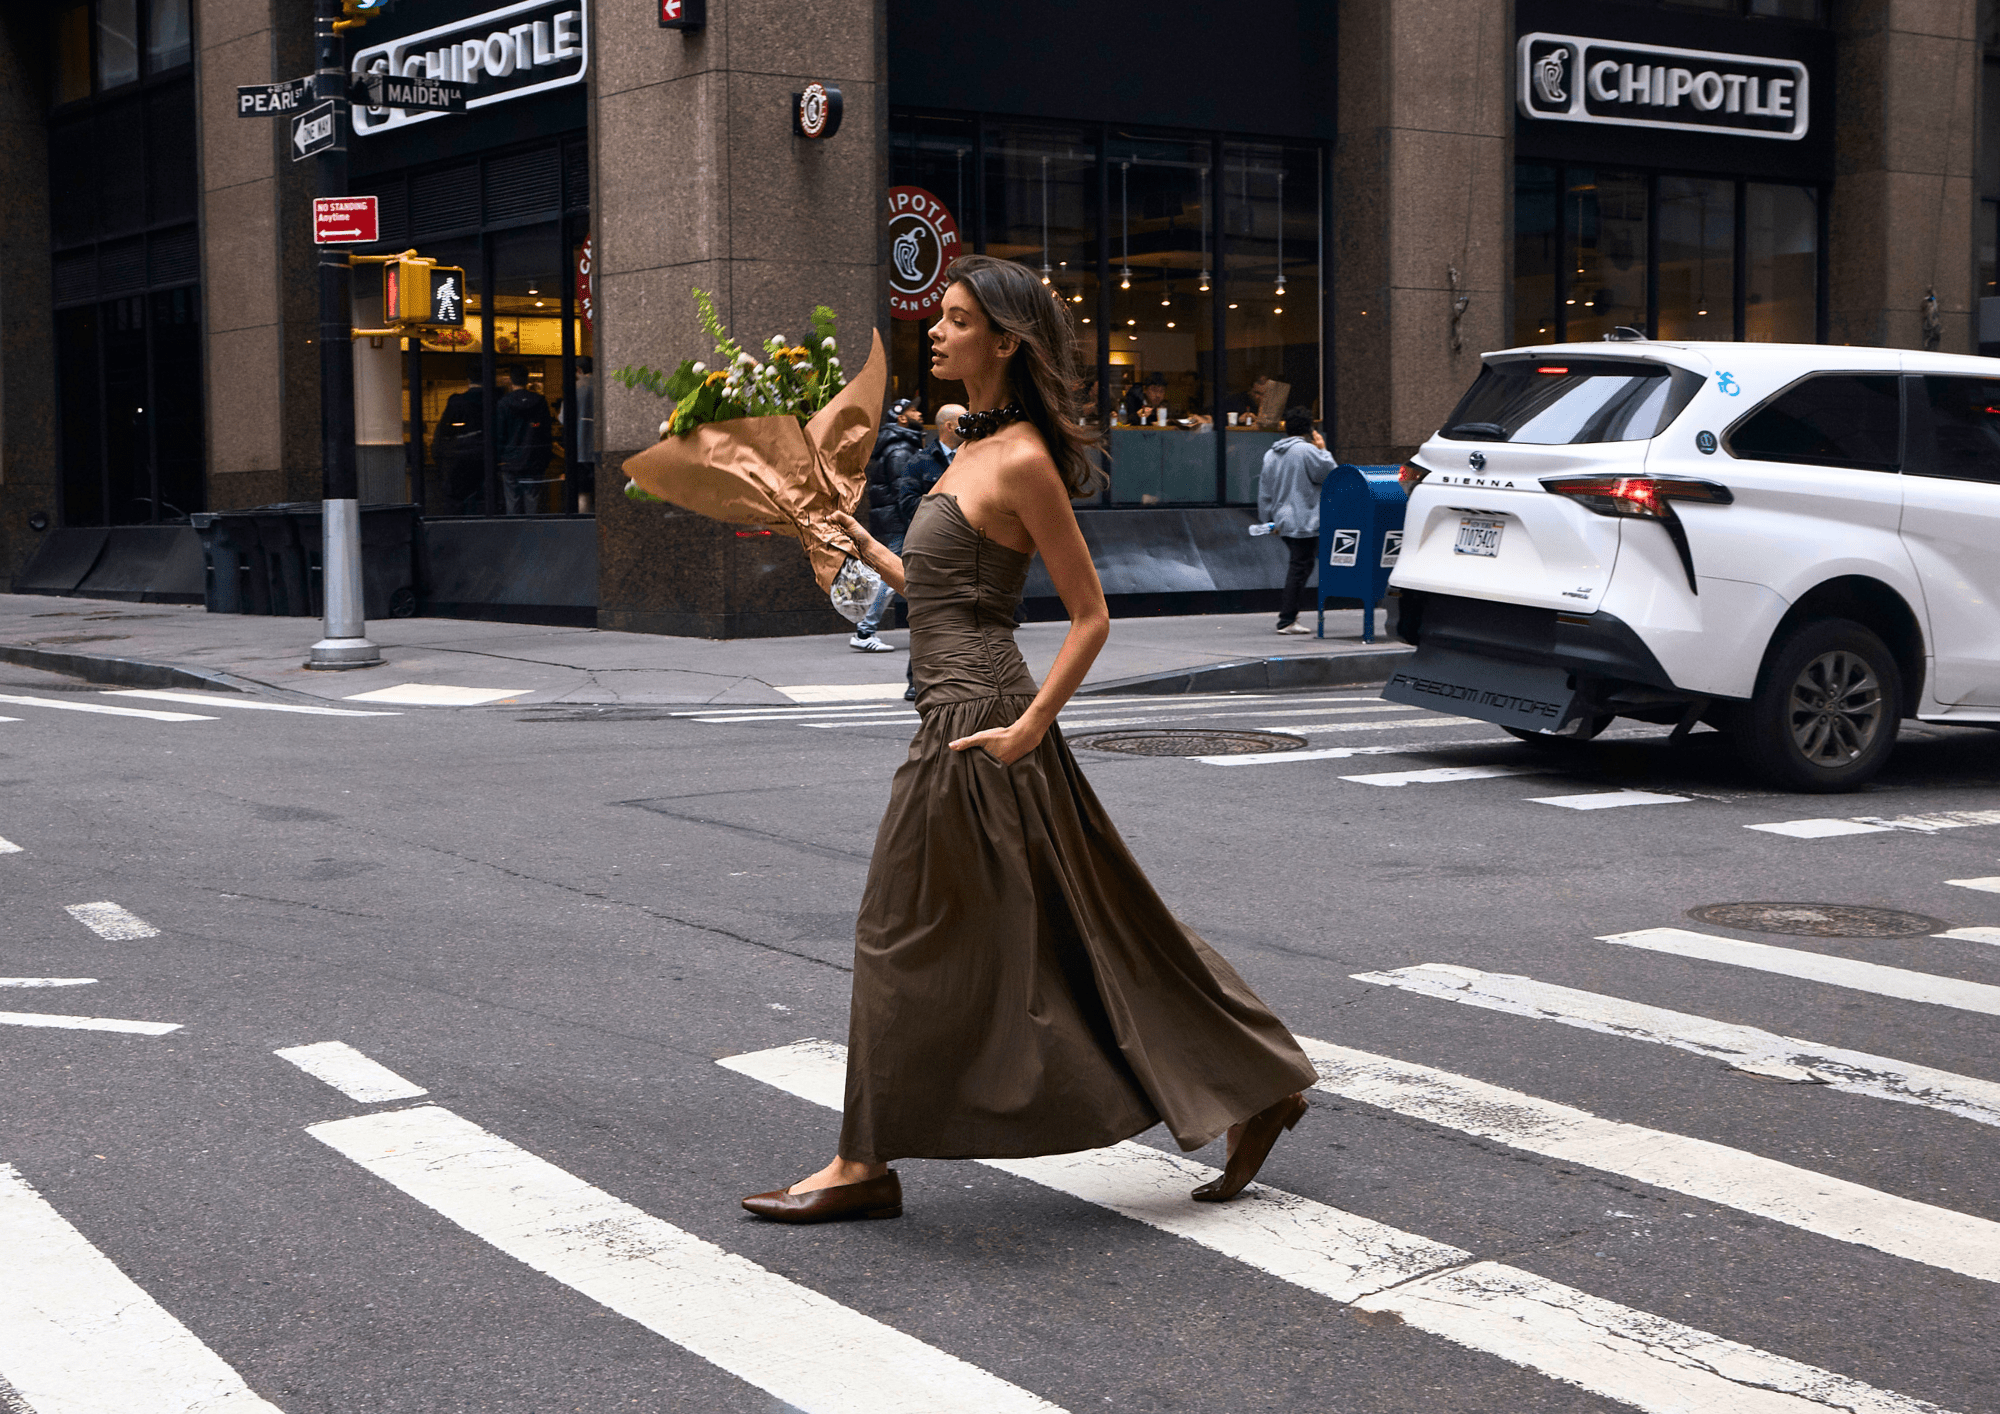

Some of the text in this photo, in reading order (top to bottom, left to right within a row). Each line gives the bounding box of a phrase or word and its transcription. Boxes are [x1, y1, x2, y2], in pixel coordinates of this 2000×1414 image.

[240, 92, 298, 112] PEARL
[295, 87, 303, 98] ST
[387, 83, 462, 107] MAIDEN LA
[1587, 60, 1795, 117] CHIPOTLE
[303, 117, 329, 142] ONE WAY
[317, 201, 368, 212] NO STANDING
[318, 212, 351, 223] Anytime
[888, 193, 957, 246] IPOTLE
[922, 280, 950, 308] GRIL
[1442, 476, 1514, 488] SIENNA
[1391, 673, 1562, 718] FREEDOM MOTORS
